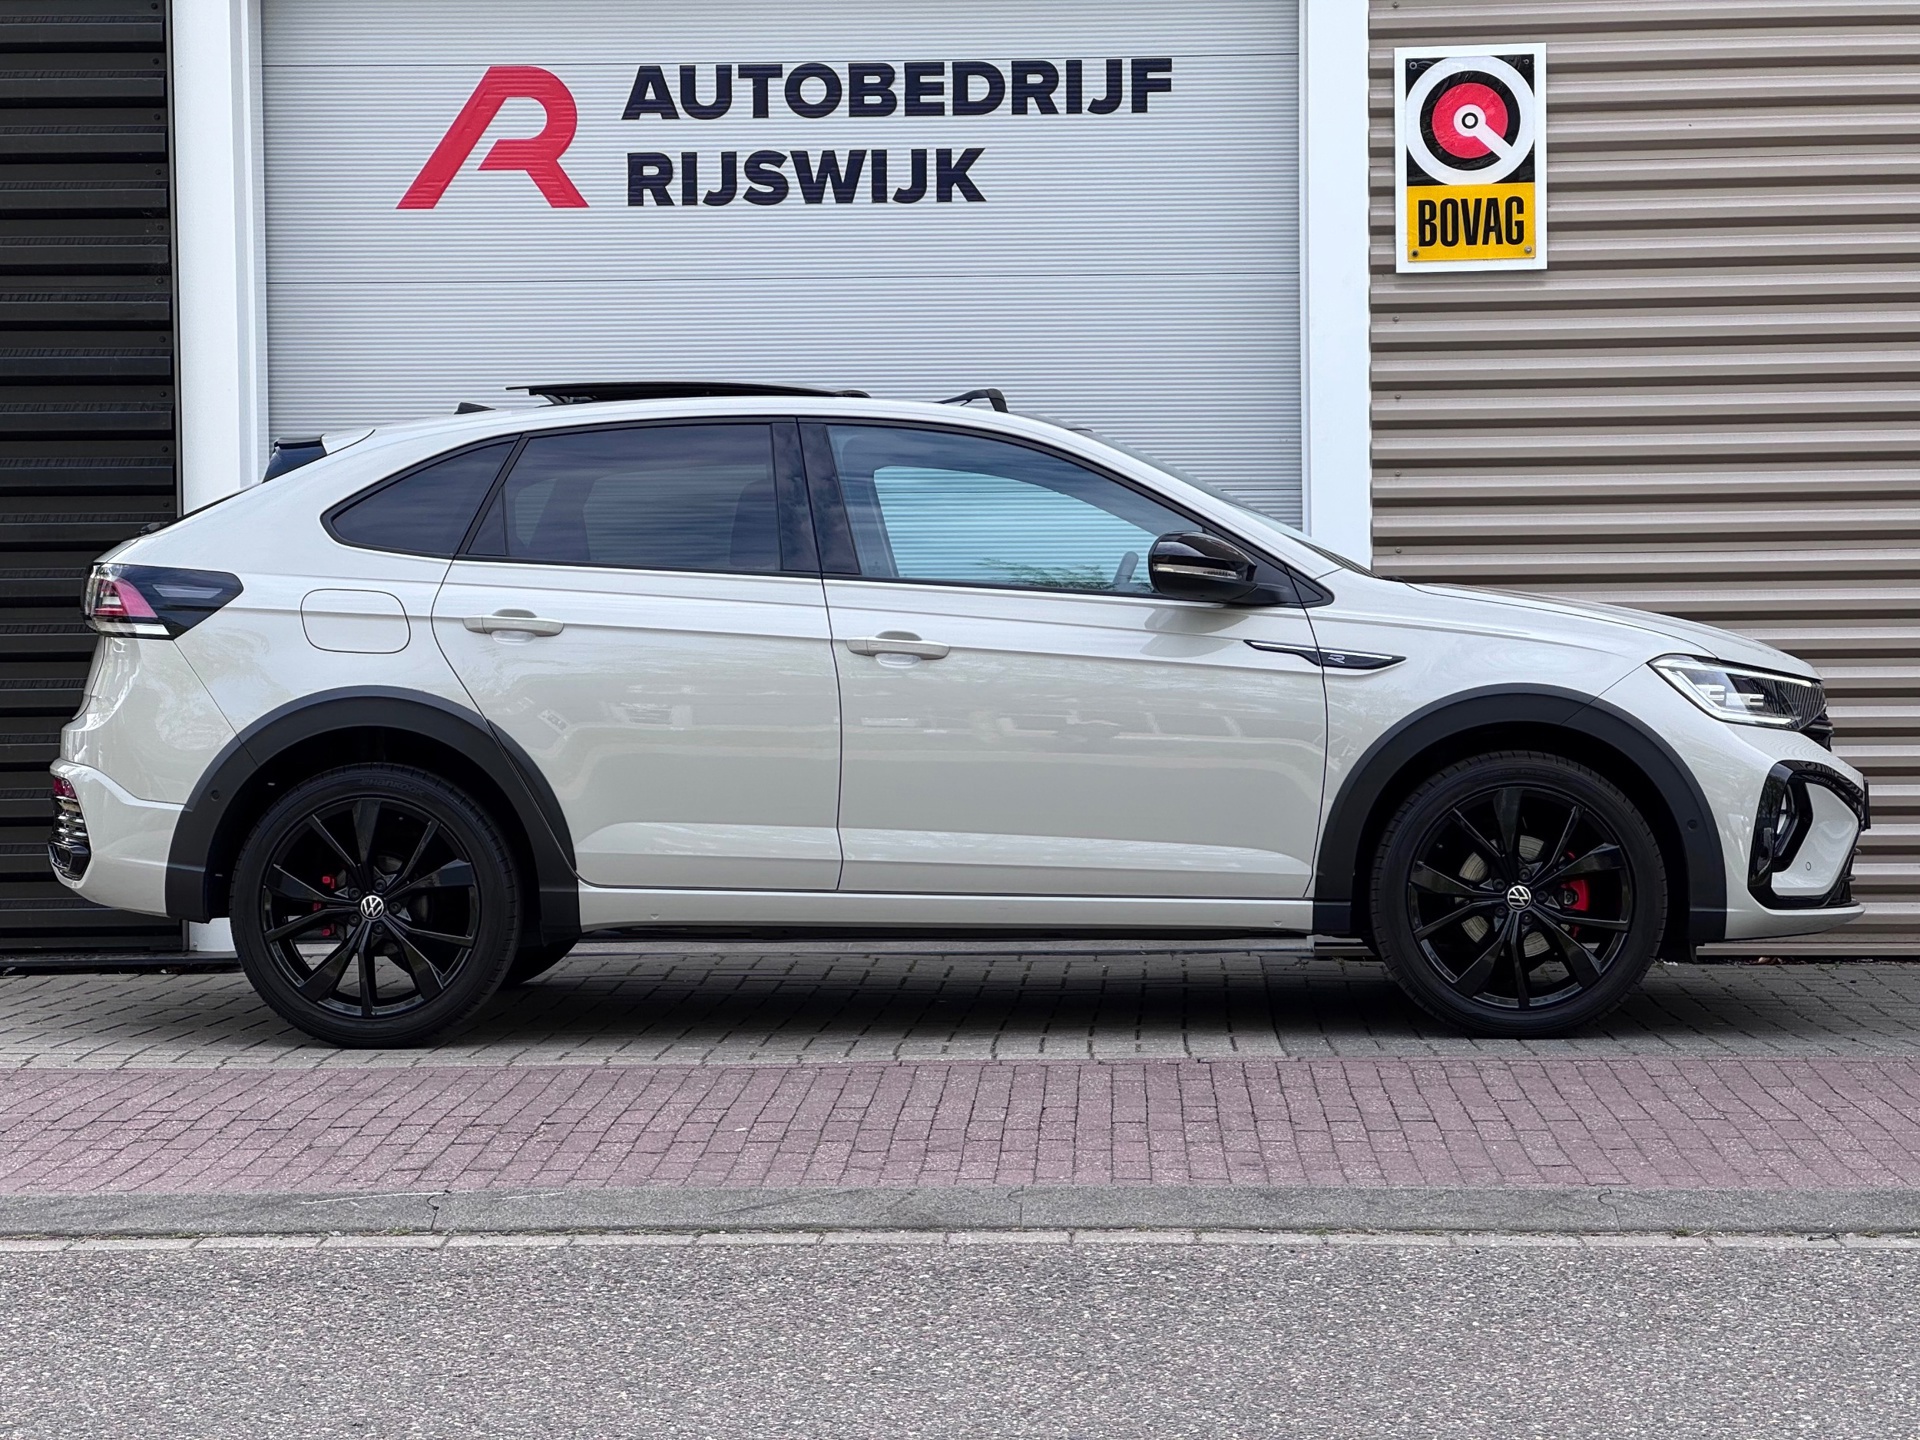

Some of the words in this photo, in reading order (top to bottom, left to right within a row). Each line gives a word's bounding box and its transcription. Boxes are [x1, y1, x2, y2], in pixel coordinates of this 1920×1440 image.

[622, 57, 1174, 120] AUTOBEDRIJF
[627, 148, 987, 206] RIJSWIJK
[1418, 196, 1525, 247] BOVAG
